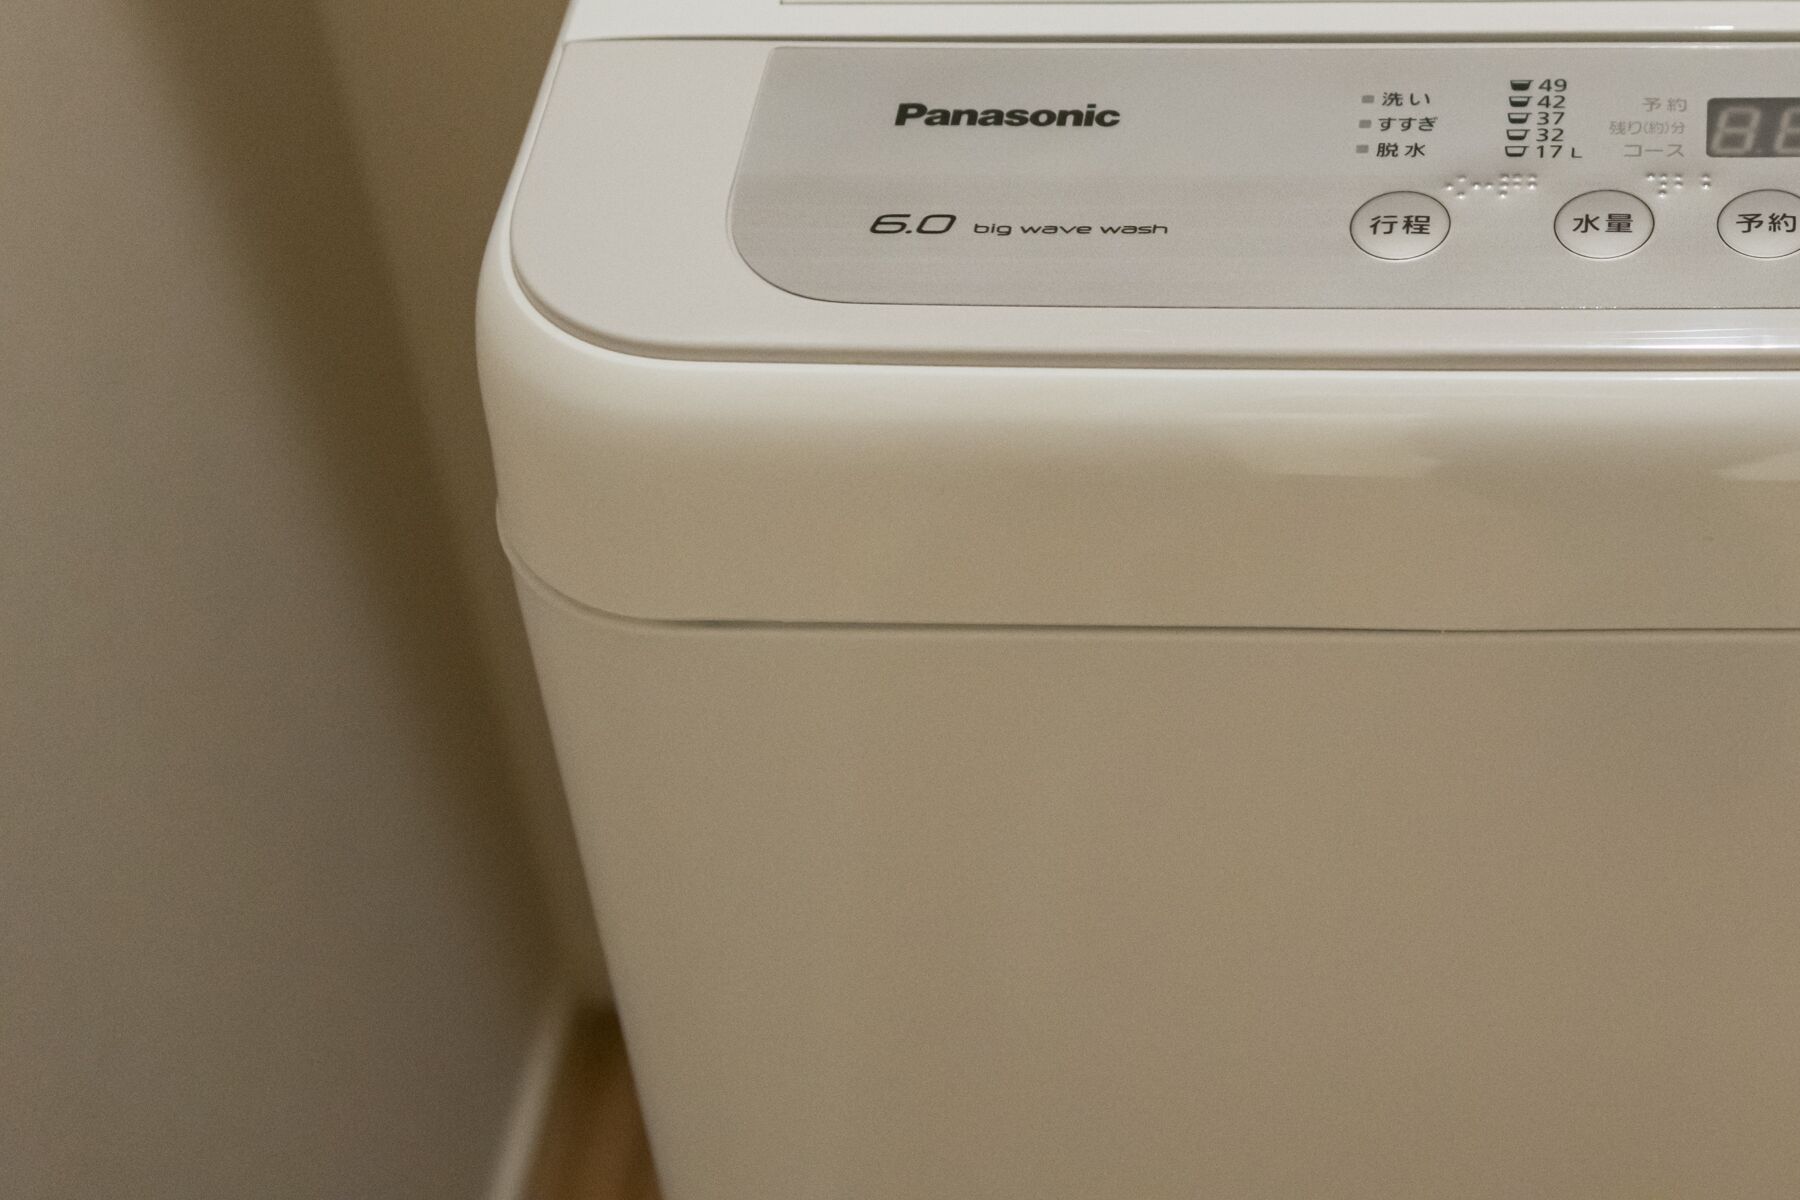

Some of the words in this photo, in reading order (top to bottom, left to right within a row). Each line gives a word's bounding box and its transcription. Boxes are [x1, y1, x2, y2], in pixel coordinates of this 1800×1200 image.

[1539, 78, 1567, 92] 49
[1381, 91, 1431, 107] 洗い
[1537, 94, 1566, 109] 42
[1642, 97, 1688, 112] 予約
[895, 102, 1120, 127] Panasonic
[1536, 111, 1565, 125] 37
[1379, 116, 1438, 132] すすぎ
[1535, 127, 1565, 141] 32
[1376, 141, 1426, 158] 脱水
[1536, 145, 1562, 158] 17
[1571, 148, 1582, 159] L
[1623, 144, 1685, 157] コース
[870, 213, 957, 235] 6.0
[973, 221, 1012, 238] big
[1020, 223, 1092, 235] wave
[1099, 221, 1169, 235] wash
[1369, 214, 1432, 236] 行程
[1572, 213, 1634, 234] 水量
[1735, 212, 1797, 233] 予約
